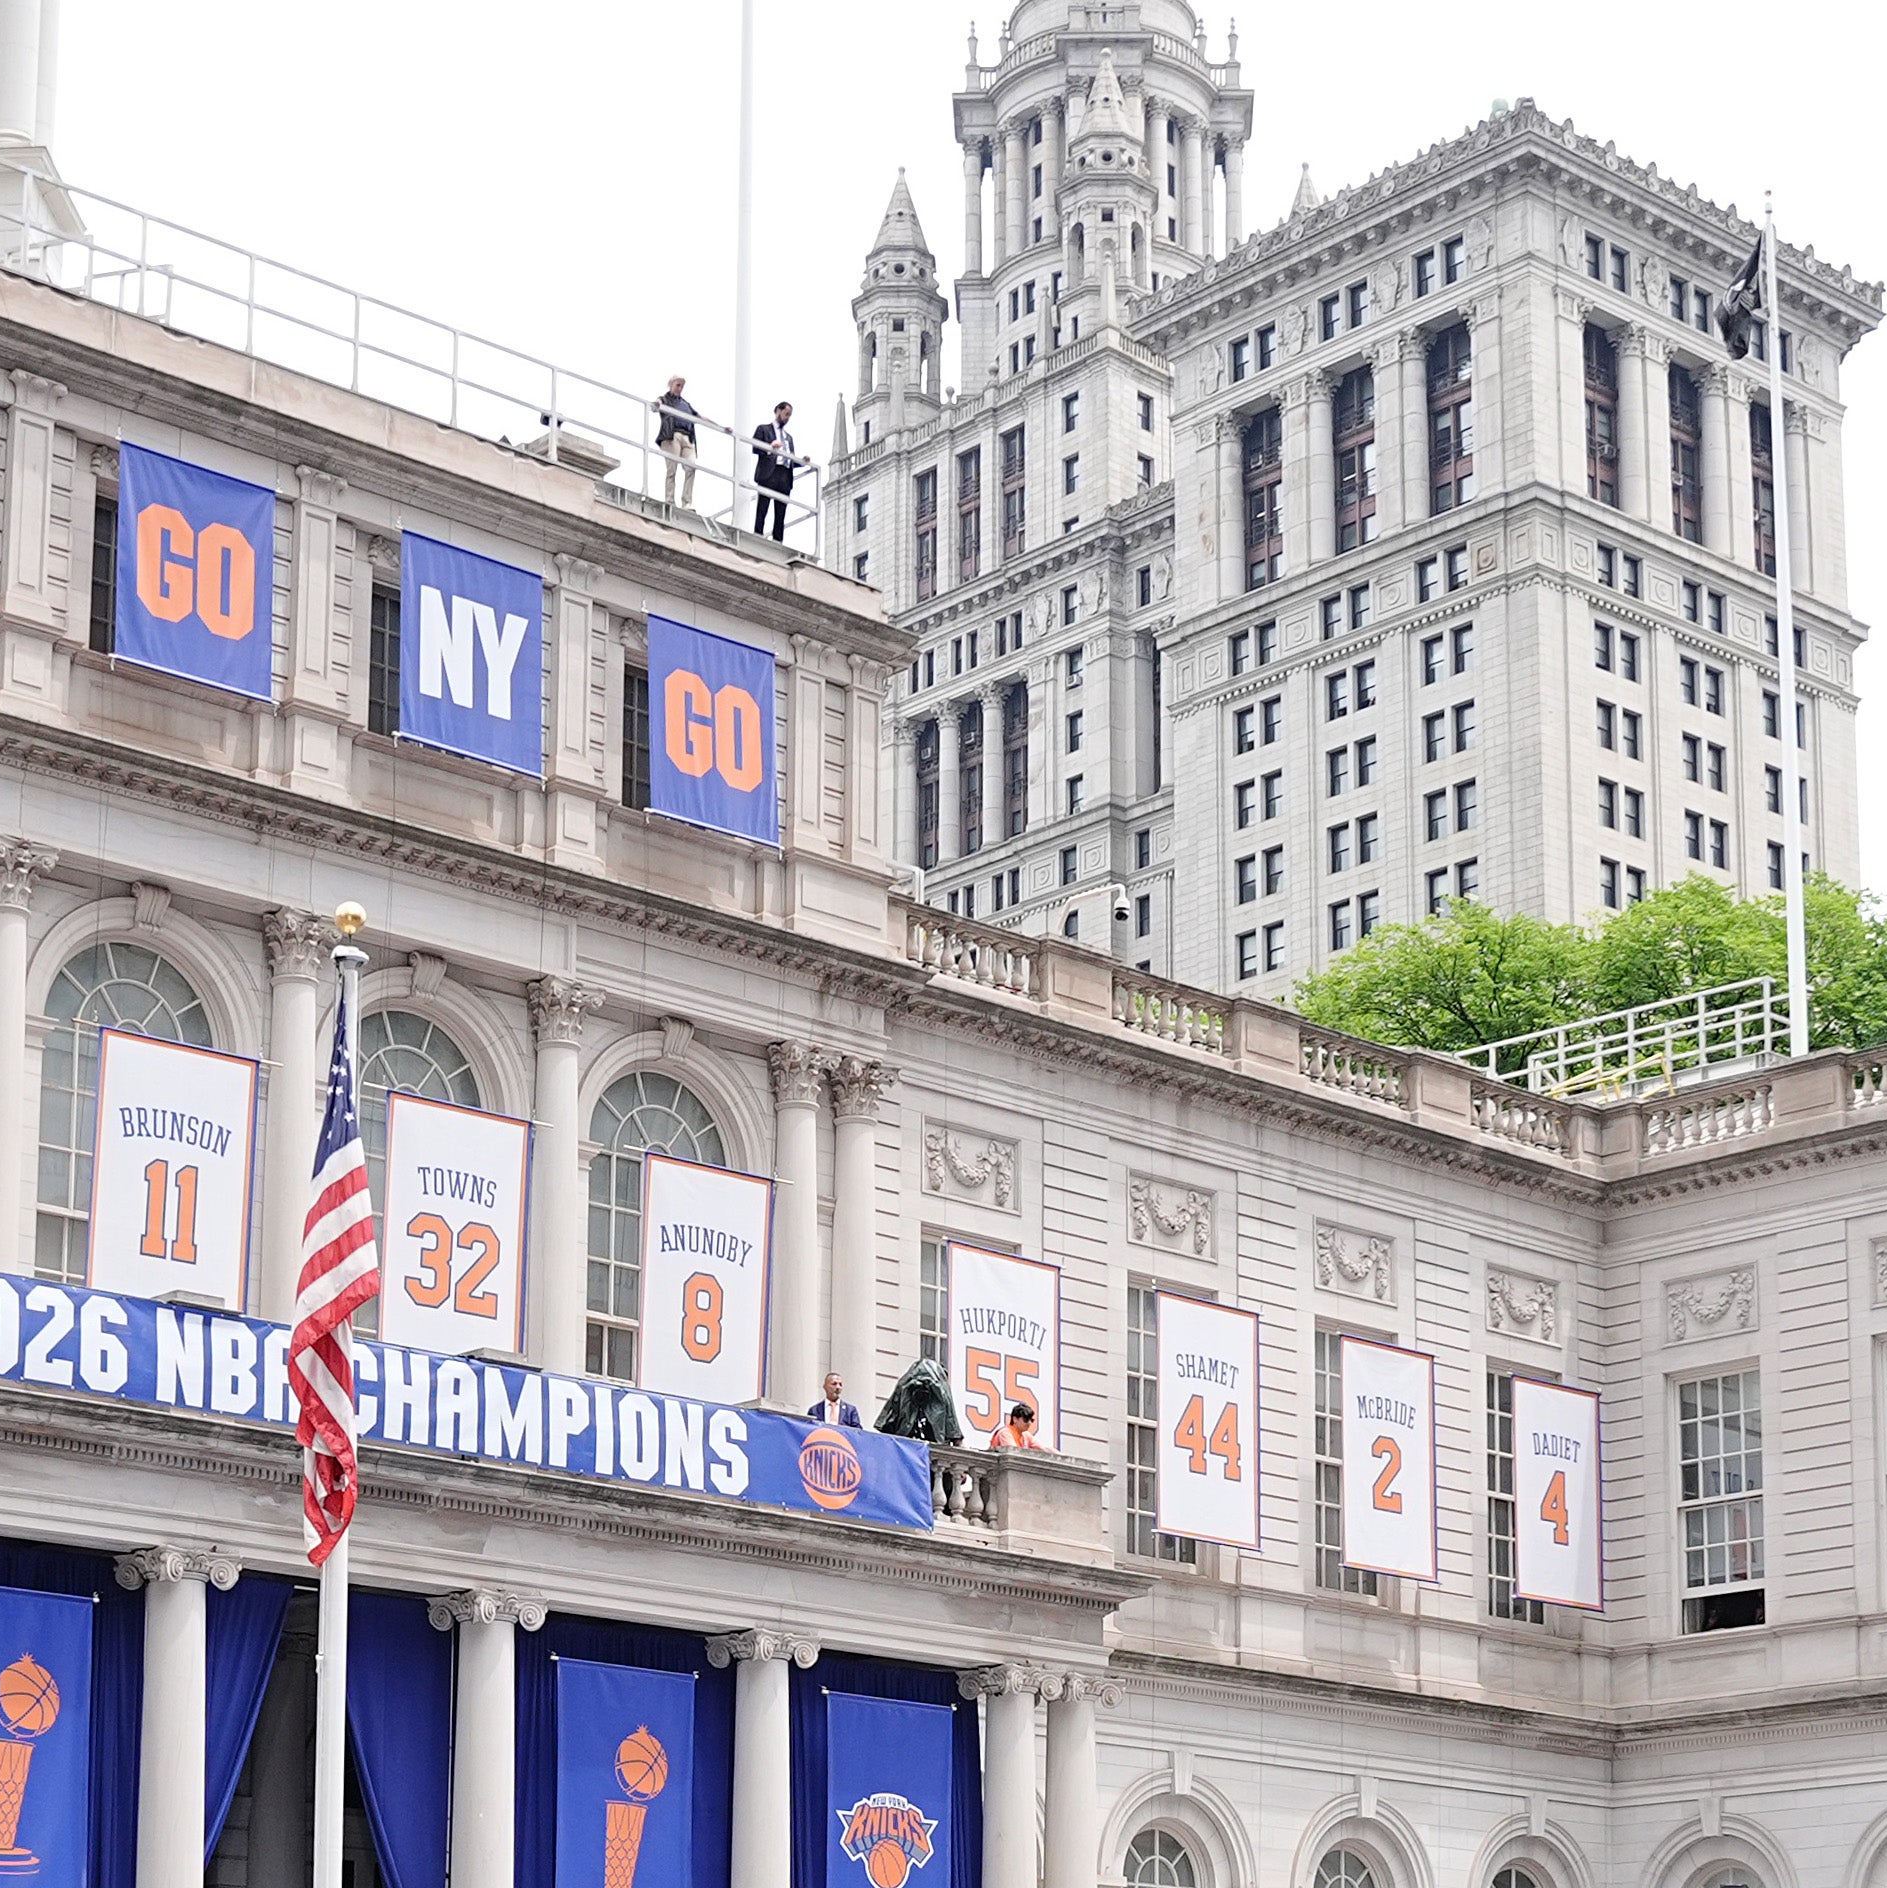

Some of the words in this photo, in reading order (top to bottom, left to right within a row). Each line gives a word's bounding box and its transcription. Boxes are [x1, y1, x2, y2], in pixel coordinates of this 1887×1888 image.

[136, 503, 255, 641] GO
[419, 585, 528, 721] NY
[664, 669, 762, 793] GO
[119, 1106, 233, 1158] BRUNSON
[140, 1158, 199, 1265] 11
[417, 1166, 499, 1210] TOWNS
[404, 1212, 501, 1320] 32
[660, 1224, 753, 1268] ANUNOBY
[680, 1271, 724, 1365] 8
[959, 1307, 1047, 1351] HUKPORTI
[156, 1308, 299, 1423] NBA
[348, 1344, 750, 1497] CHAMPIONS
[965, 1345, 1040, 1436] 55
[1175, 1352, 1240, 1390] SHAMET
[1174, 1394, 1242, 1482] 44
[1356, 1395, 1417, 1430] McBRIDE
[1532, 1432, 1582, 1464] DADIET
[804, 1448, 856, 1489] KNICKS
[1371, 1435, 1403, 1515] 2
[1540, 1470, 1570, 1546] 4
[844, 1804, 931, 1853] KNICKS
